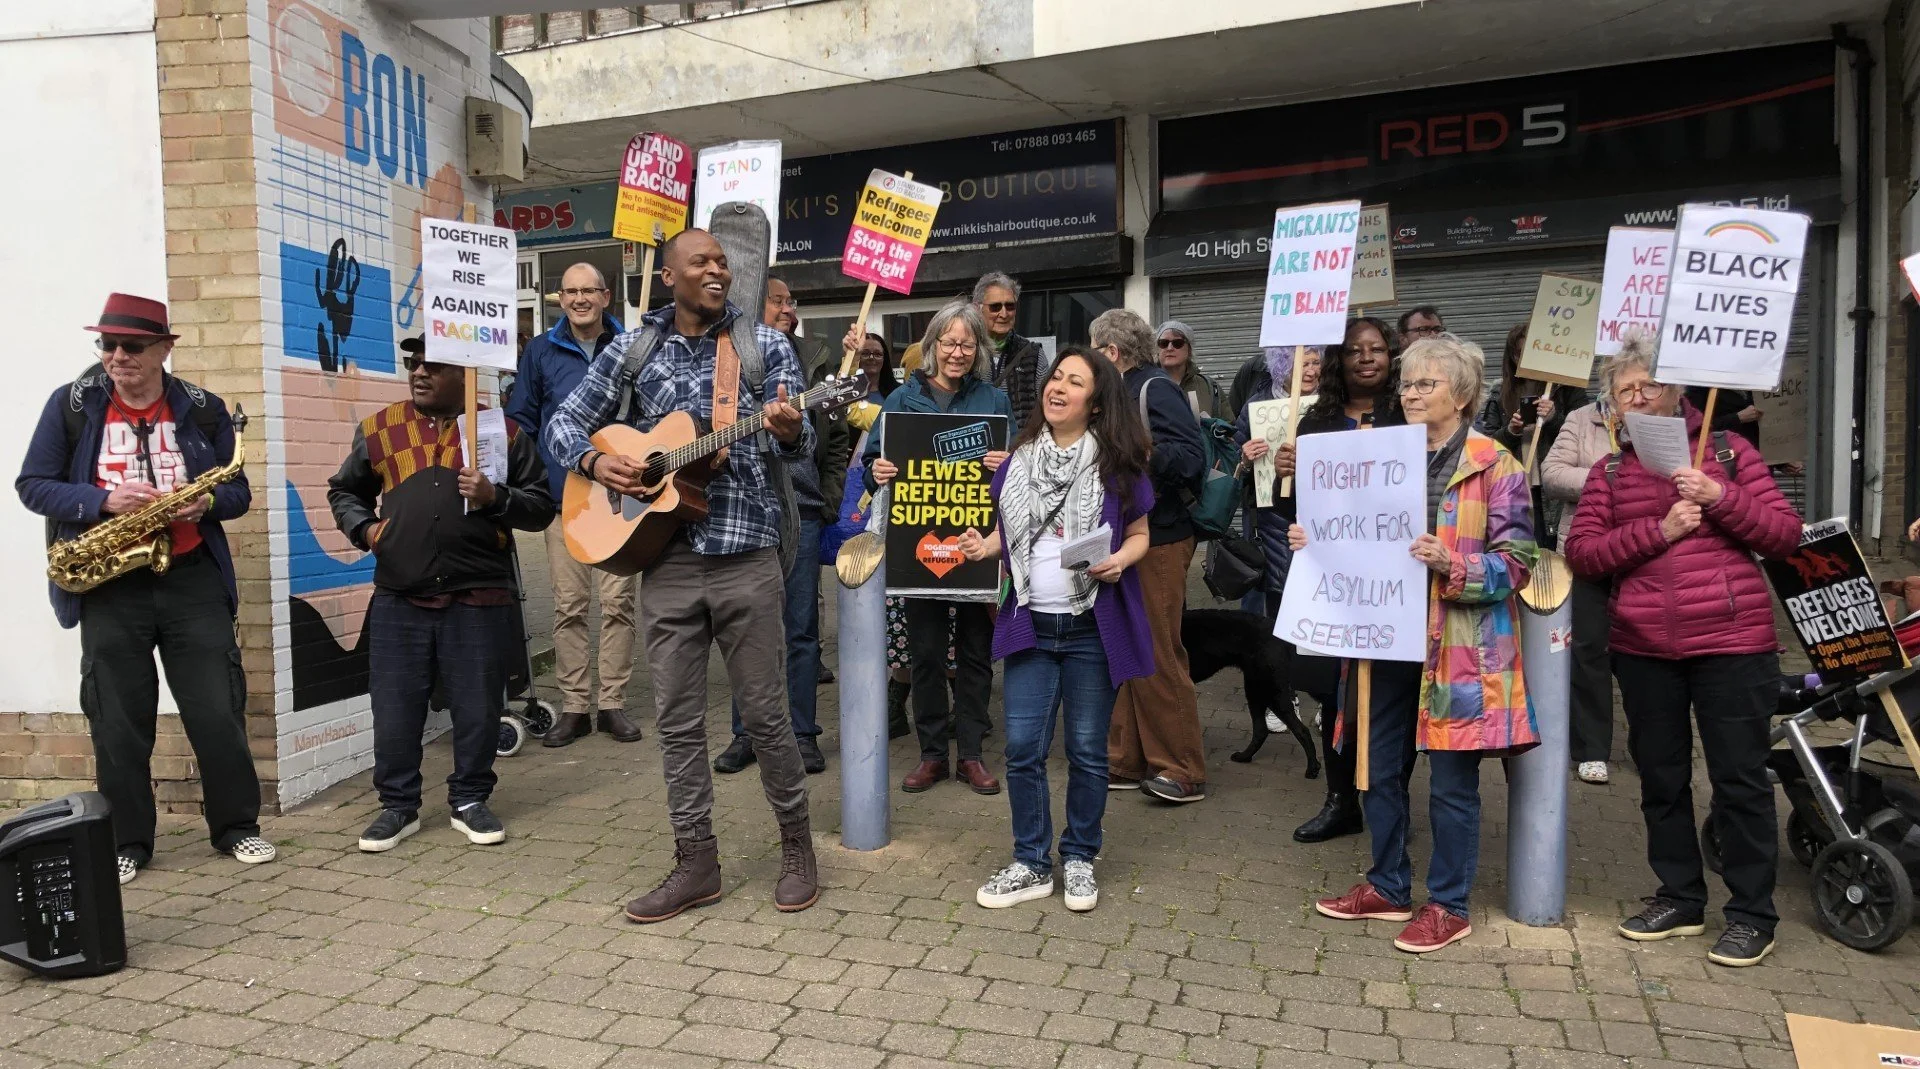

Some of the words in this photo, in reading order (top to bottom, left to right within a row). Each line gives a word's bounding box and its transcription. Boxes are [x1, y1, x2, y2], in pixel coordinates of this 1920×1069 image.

[341, 30, 428, 190] BON
[991, 141, 1013, 153] Tel:
[1016, 136, 1050, 150] 07888
[1052, 133, 1073, 146] 093
[1075, 130, 1096, 143] 465
[1381, 111, 1508, 160] RED
[1522, 104, 1566, 147] 5
[631, 133, 683, 163] STAND
[627, 148, 653, 169] UP
[657, 158, 677, 178] TO
[707, 158, 762, 177] STAND
[781, 165, 802, 177] reet
[624, 166, 688, 202] RACISM
[723, 180, 740, 191] UP
[785, 194, 839, 219] KI'S
[941, 165, 1098, 203] BOUTIQUE
[620, 202, 635, 211] and
[622, 191, 633, 201] No
[635, 194, 643, 203] to
[865, 190, 931, 223] Refugees
[430, 225, 508, 249] TOGETHER
[861, 210, 923, 239] welcome
[1276, 212, 1358, 239] MIGRANTS
[1399, 227, 1417, 237] CTS
[458, 250, 480, 265] WE
[776, 240, 812, 253] SALON
[852, 229, 886, 255] Stop
[888, 242, 912, 261] the
[1185, 242, 1209, 258] 40
[1214, 237, 1251, 259] High
[1633, 246, 1668, 266] WE
[847, 247, 869, 266] far
[870, 258, 907, 279] right
[1272, 251, 1310, 275] ARE
[1313, 247, 1352, 271] NOT
[1686, 250, 1790, 281] BLACK
[453, 269, 485, 286] RISE
[1623, 274, 1669, 295] ARE
[1270, 293, 1291, 316] TO
[1294, 291, 1348, 315] BLAME
[1555, 281, 1596, 307] Say
[1695, 292, 1768, 317] LIVES
[432, 295, 508, 319] AGAINST
[1617, 296, 1661, 318] ALL
[433, 320, 508, 345] RACISM
[1549, 320, 1571, 337] to
[1673, 323, 1777, 350] MATTER
[945, 434, 983, 452] LOSRAS
[907, 459, 982, 482] LEWES
[1311, 460, 1375, 490] RIGHT
[1382, 459, 1407, 487] TO
[894, 482, 992, 505] REFUGEE
[891, 505, 993, 527] SUPPORT
[1311, 514, 1366, 541] WORK
[1375, 511, 1413, 542] FOR
[1805, 525, 1837, 541] Worker
[932, 550, 950, 558] WITH
[1312, 572, 1404, 606] ASYLUM
[1785, 576, 1875, 622] REFUGEES
[1290, 618, 1395, 649] SEEKERS
[1796, 602, 1886, 645] WELCOME
[1816, 641, 1844, 657] Open
[1843, 636, 1861, 648] the
[1823, 657, 1840, 670] No
[1841, 645, 1892, 665] deportations
